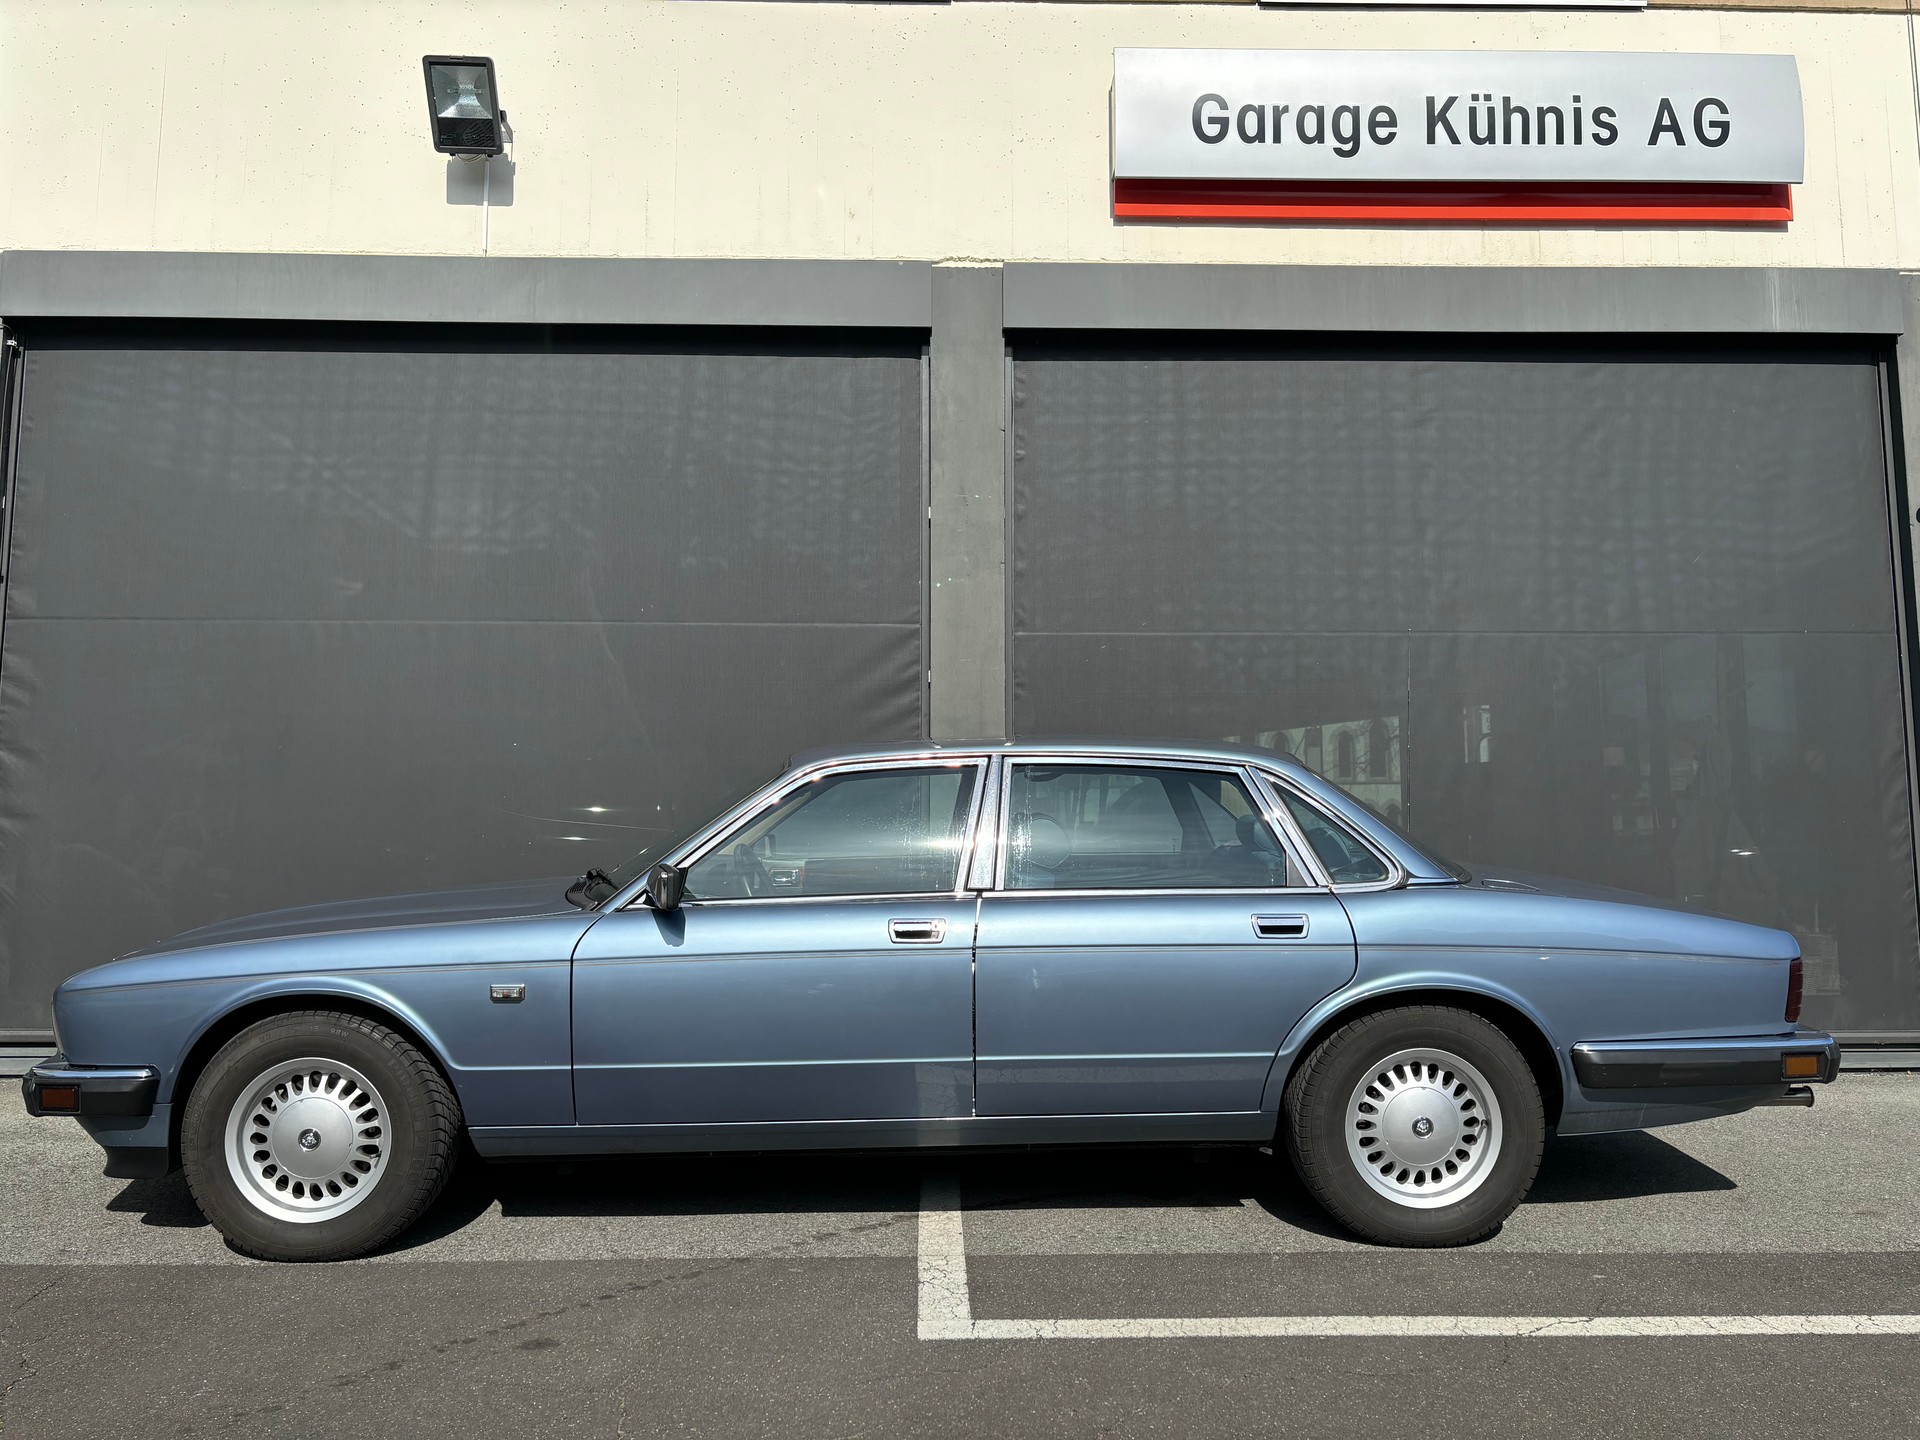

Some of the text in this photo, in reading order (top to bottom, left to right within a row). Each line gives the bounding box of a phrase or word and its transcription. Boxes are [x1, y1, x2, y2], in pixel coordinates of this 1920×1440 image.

[1191, 94, 1731, 159] Garage Kühnis AG
